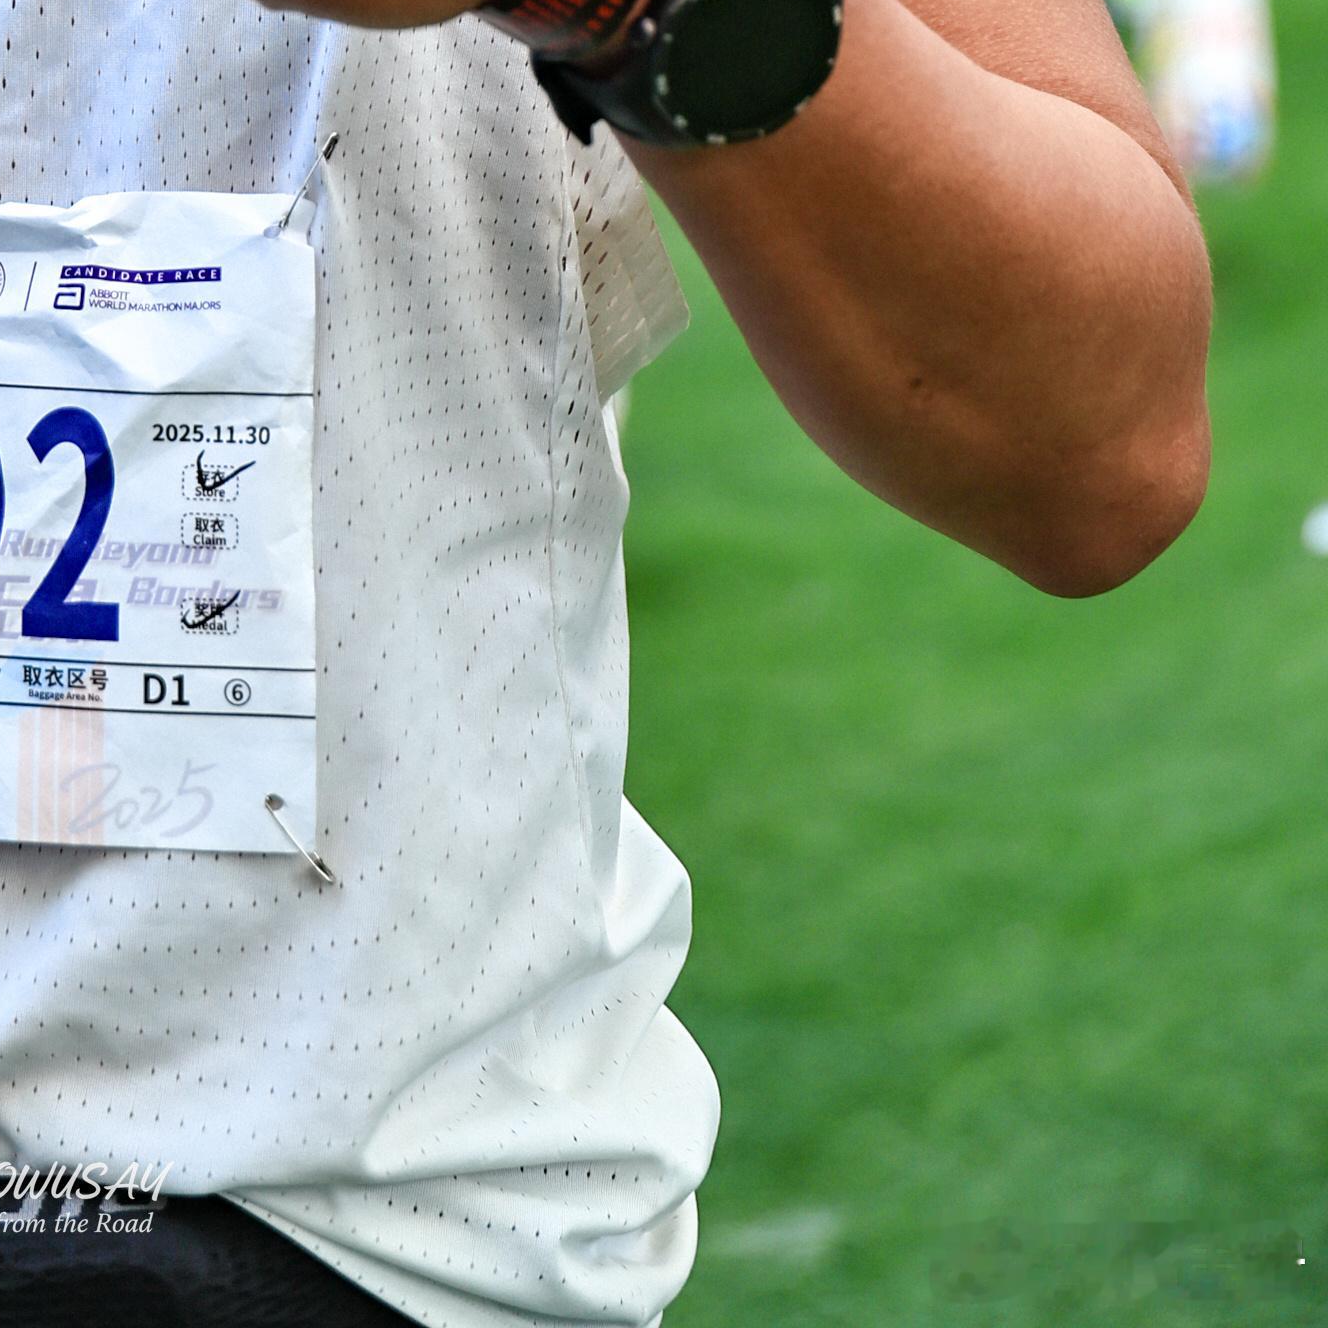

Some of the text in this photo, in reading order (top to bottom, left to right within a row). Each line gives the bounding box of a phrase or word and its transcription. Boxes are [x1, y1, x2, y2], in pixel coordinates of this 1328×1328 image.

[63, 266, 218, 283] CANDIDATE RACE
[90, 288, 130, 301] ABBOTT
[88, 298, 221, 312] WORLD MARATHON MAJORS
[152, 423, 271, 445] 2025.11.30
[195, 517, 225, 533] 取衣
[193, 534, 227, 546] Claim
[125, 577, 284, 611] Borders
[22, 664, 109, 691] 取衣区号
[28, 688, 104, 703] Baggage Area No.
[143, 672, 190, 706] D1
[59, 758, 218, 839] 2025
